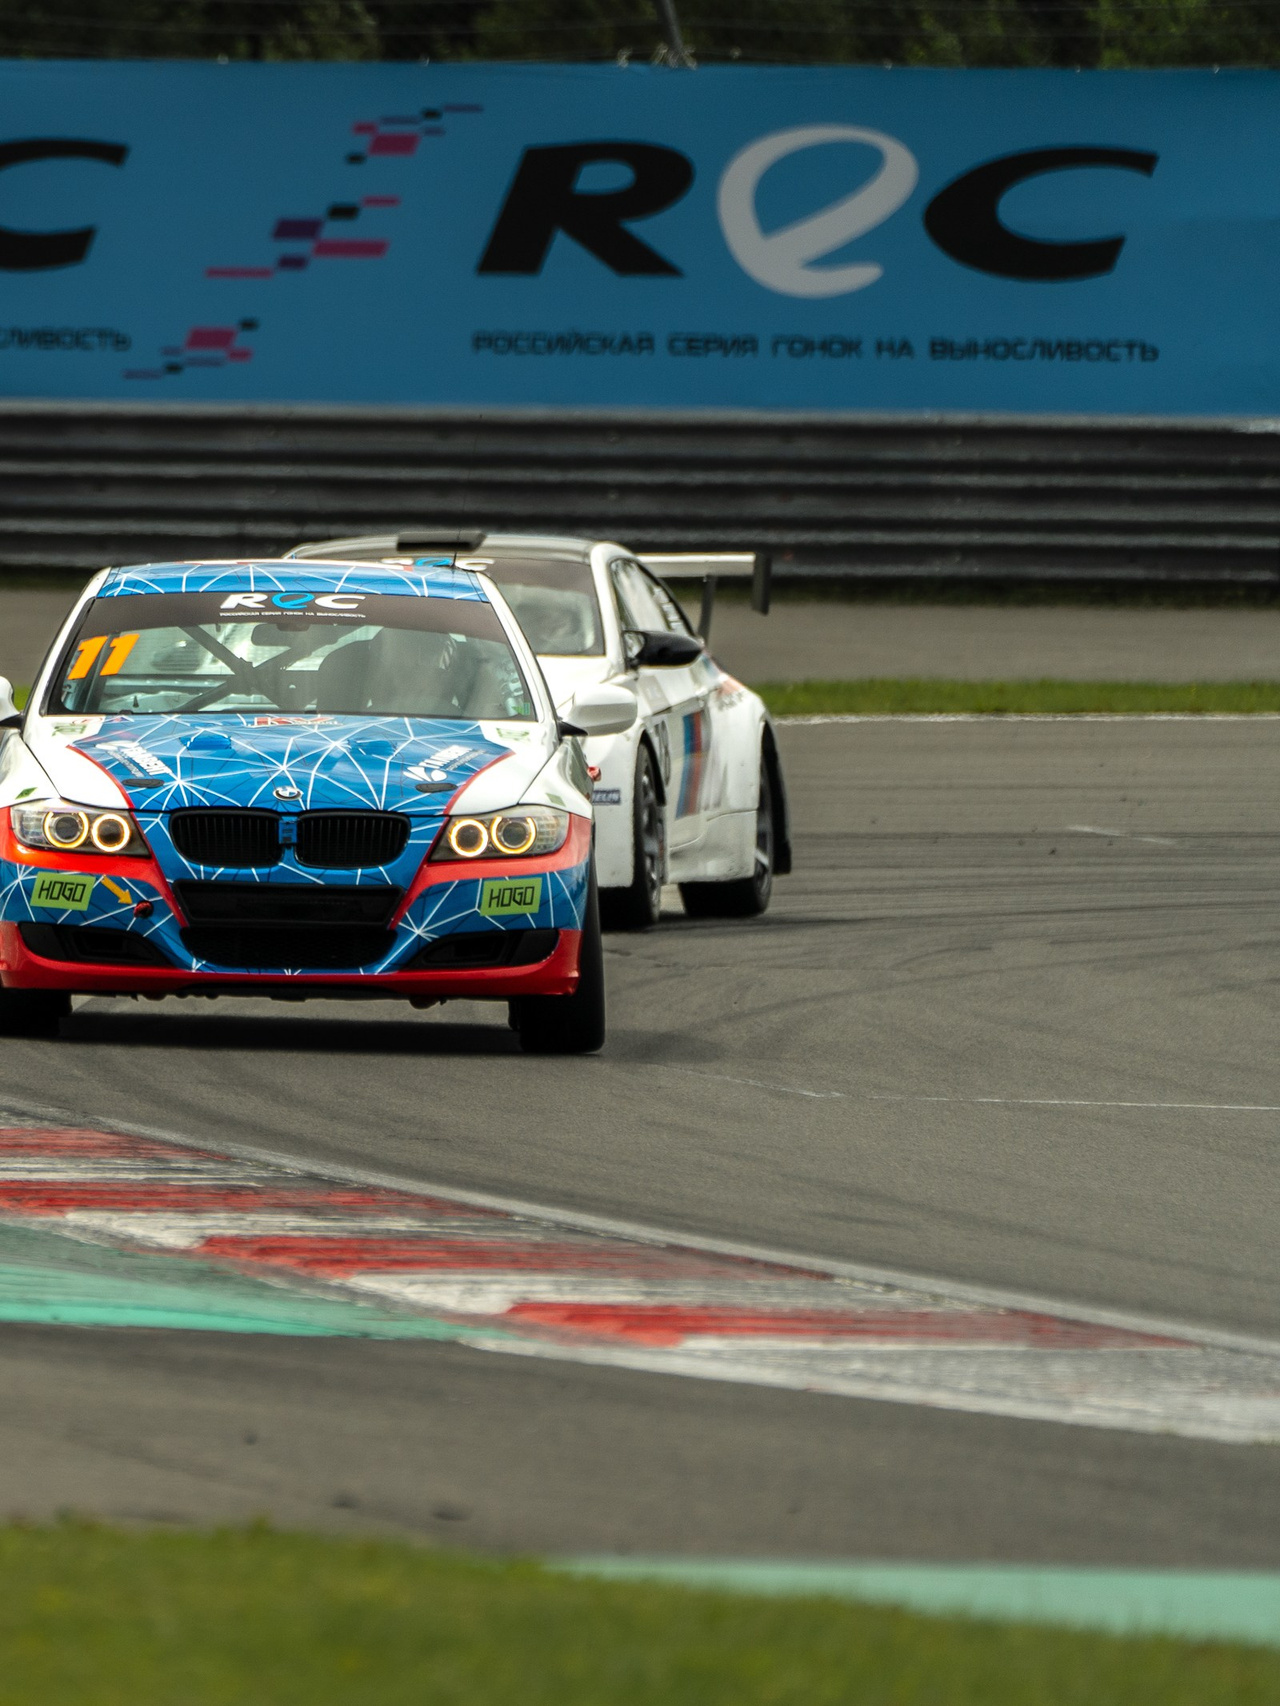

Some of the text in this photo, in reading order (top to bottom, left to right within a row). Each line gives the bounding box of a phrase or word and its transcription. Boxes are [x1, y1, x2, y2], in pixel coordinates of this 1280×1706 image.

[668, 332, 758, 357] СЕРИЯ
[772, 334, 863, 359] ГОНОК
[875, 337, 915, 359] НА
[929, 338, 1160, 363] ВЫНОСЛИВОСТЬ
[67, 633, 140, 680] 11
[37, 879, 87, 904] HOGO
[487, 885, 535, 909] HOGO
